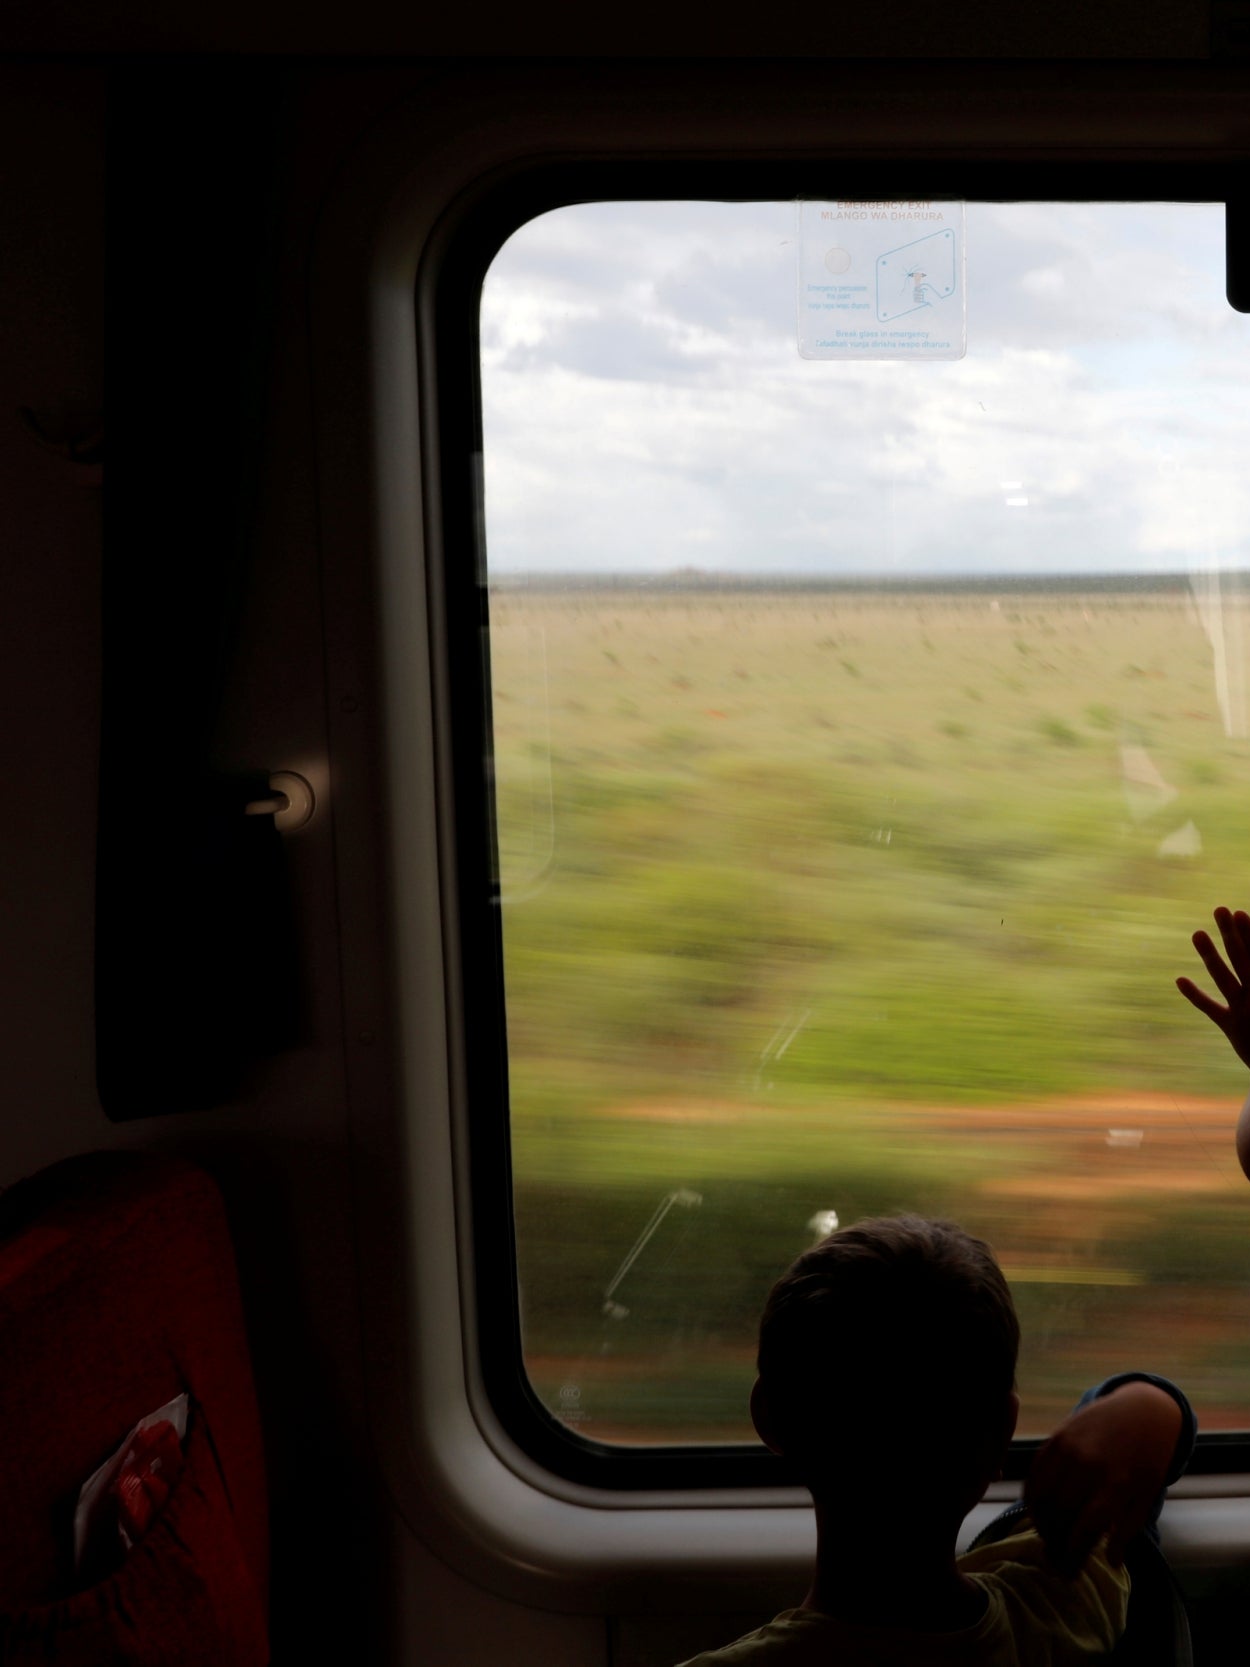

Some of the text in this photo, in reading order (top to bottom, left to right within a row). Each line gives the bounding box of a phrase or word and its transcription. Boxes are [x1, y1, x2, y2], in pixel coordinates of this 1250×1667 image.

[837, 201, 931, 210] EMERGENCY EXIT
[821, 211, 944, 221] MLANGO WA DHARURA
[836, 329, 929, 340] Break glass in emergency
[922, 339, 950, 348] dharura
